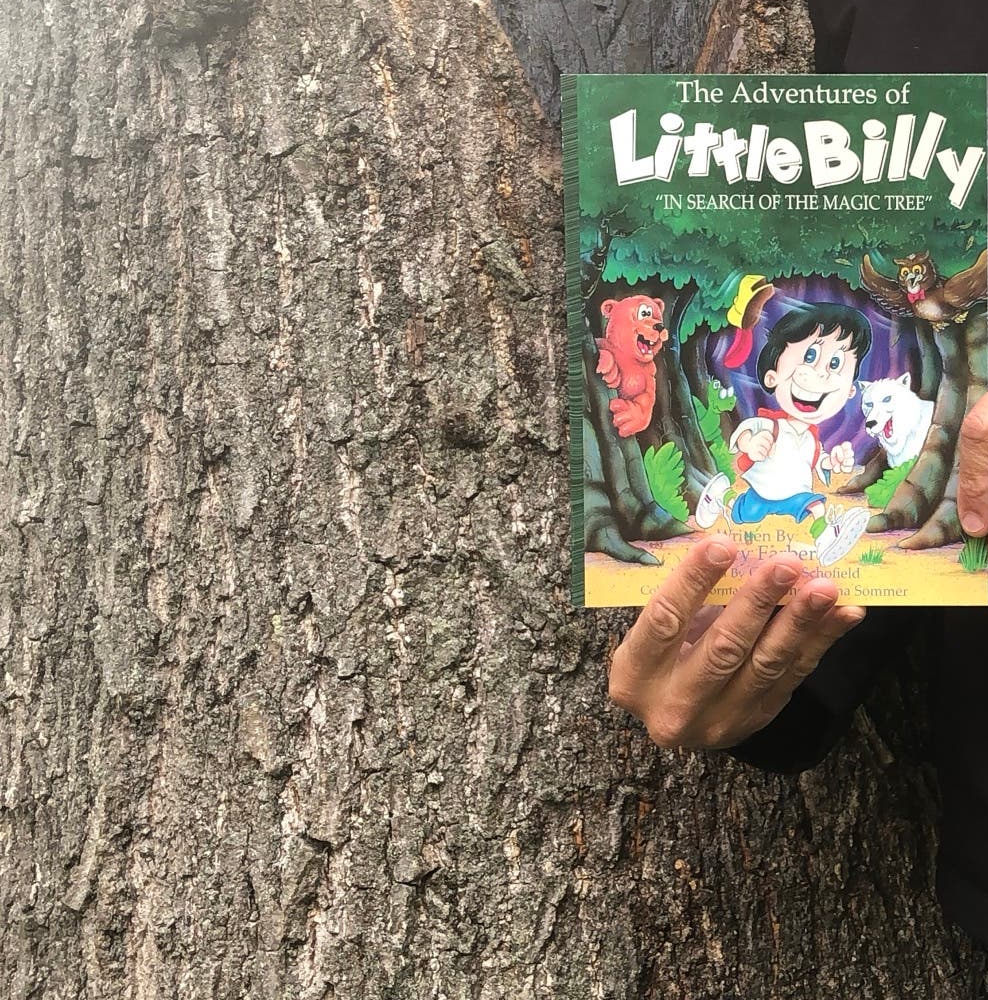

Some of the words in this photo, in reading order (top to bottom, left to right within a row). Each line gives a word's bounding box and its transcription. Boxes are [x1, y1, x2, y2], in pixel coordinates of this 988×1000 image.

[676, 79, 724, 104] The
[731, 80, 878, 104] Adventures
[885, 81, 911, 104] of
[609, 108, 803, 186] Little
[803, 110, 986, 210] Billy
[687, 194, 755, 210] SEARCH
[758, 194, 782, 210] OF
[784, 194, 819, 210] THE
[822, 194, 881, 211] MAGIC
[776, 529, 795, 545] By
[801, 566, 861, 579] Schofield
[854, 584, 909, 597] Sommer
